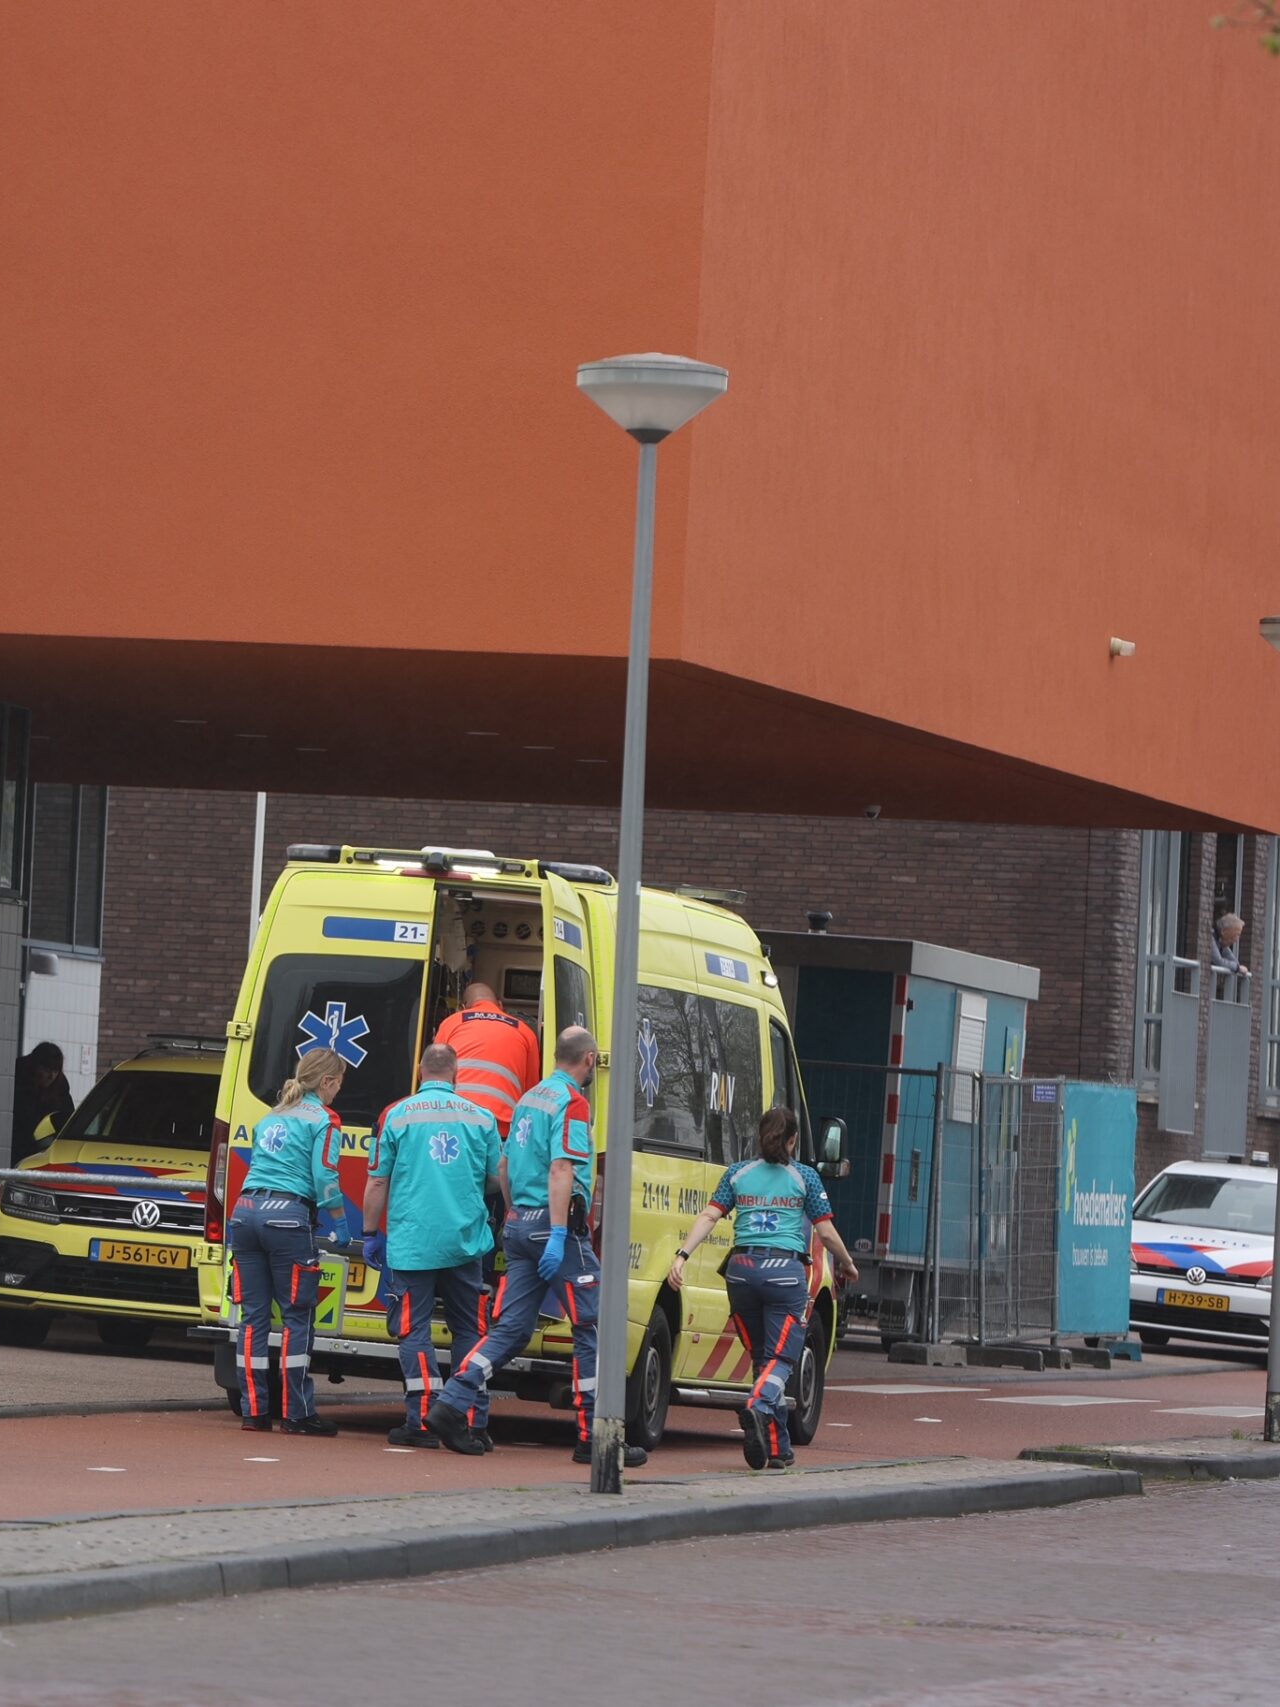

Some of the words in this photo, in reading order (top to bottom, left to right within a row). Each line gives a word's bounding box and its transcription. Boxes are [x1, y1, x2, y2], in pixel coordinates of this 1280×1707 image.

[398, 925, 425, 940] 21-
[710, 1071, 735, 1113] RAV
[404, 1100, 477, 1113] AMBULANCE
[96, 1156, 208, 1169] AMBULAN
[642, 1181, 670, 1212] 21-114
[1073, 1178, 1127, 1227] hoedemakers
[107, 1245, 179, 1266] J-561-GV
[1168, 1292, 1224, 1310] H-739-SB
